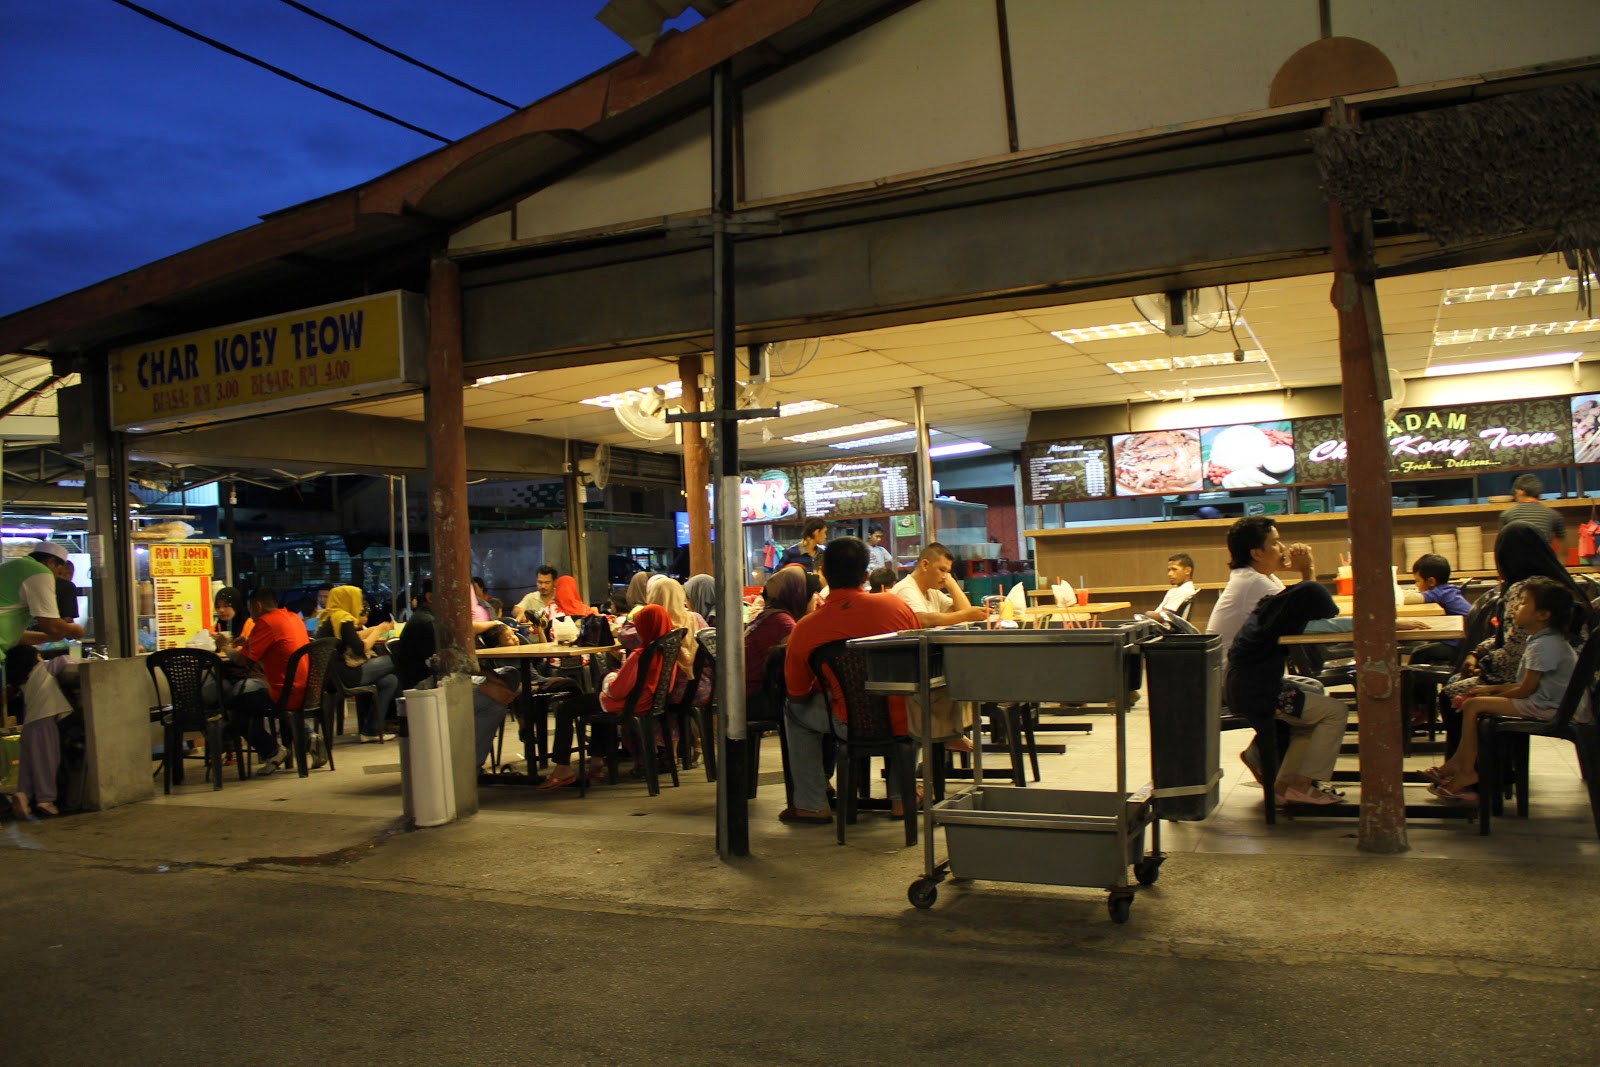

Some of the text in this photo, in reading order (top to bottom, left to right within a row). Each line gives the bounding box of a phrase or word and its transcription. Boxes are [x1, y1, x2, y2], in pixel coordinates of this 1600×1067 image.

[137, 310, 364, 388] CHAR KOEY TEOW
[217, 379, 239, 401] 3.00
[325, 360, 350, 382] 4.00
[1308, 427, 1557, 462] Ch Koay Teow
[155, 548, 208, 559] ROTI JOHN
